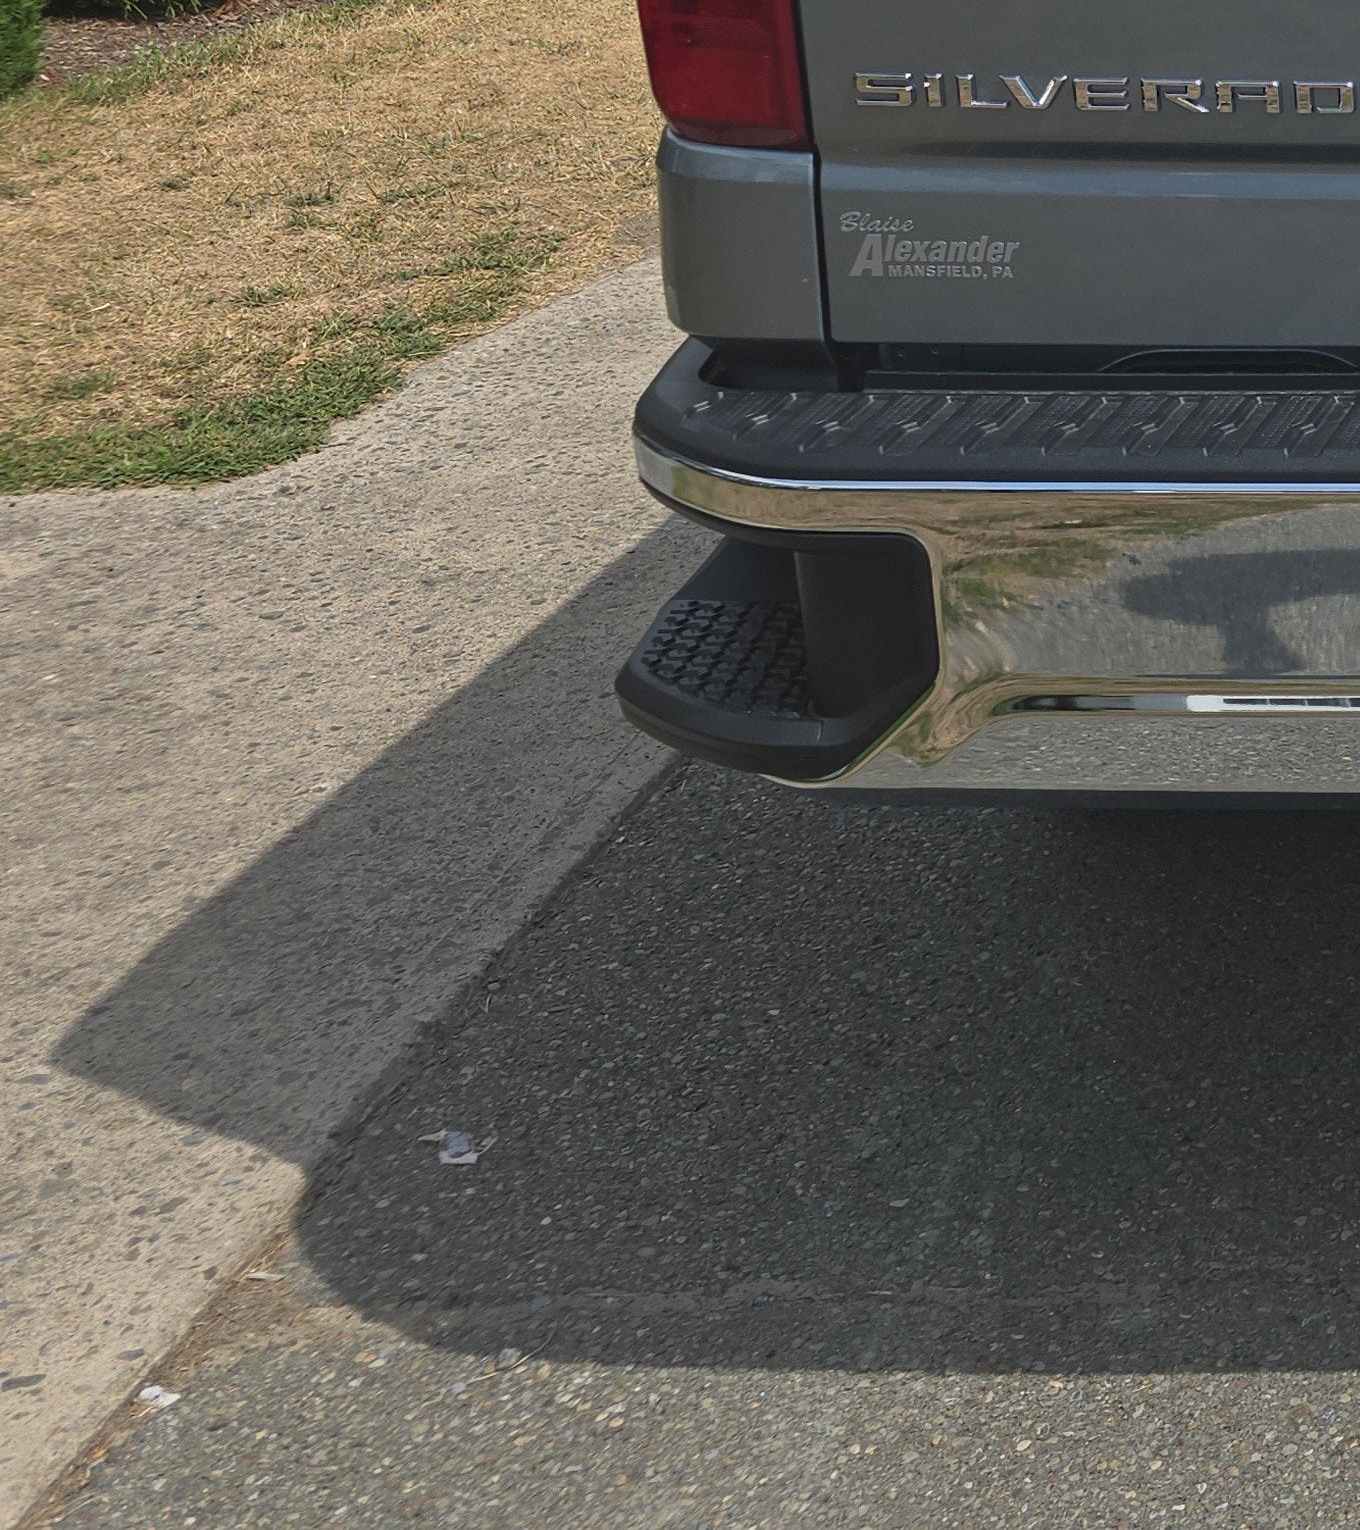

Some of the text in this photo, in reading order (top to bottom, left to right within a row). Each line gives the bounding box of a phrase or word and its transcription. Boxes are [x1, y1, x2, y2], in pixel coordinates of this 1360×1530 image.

[839, 211, 915, 232] Blaise
[850, 233, 1021, 277] Alexander
[887, 265, 1014, 281] MANSFIELD, PA
